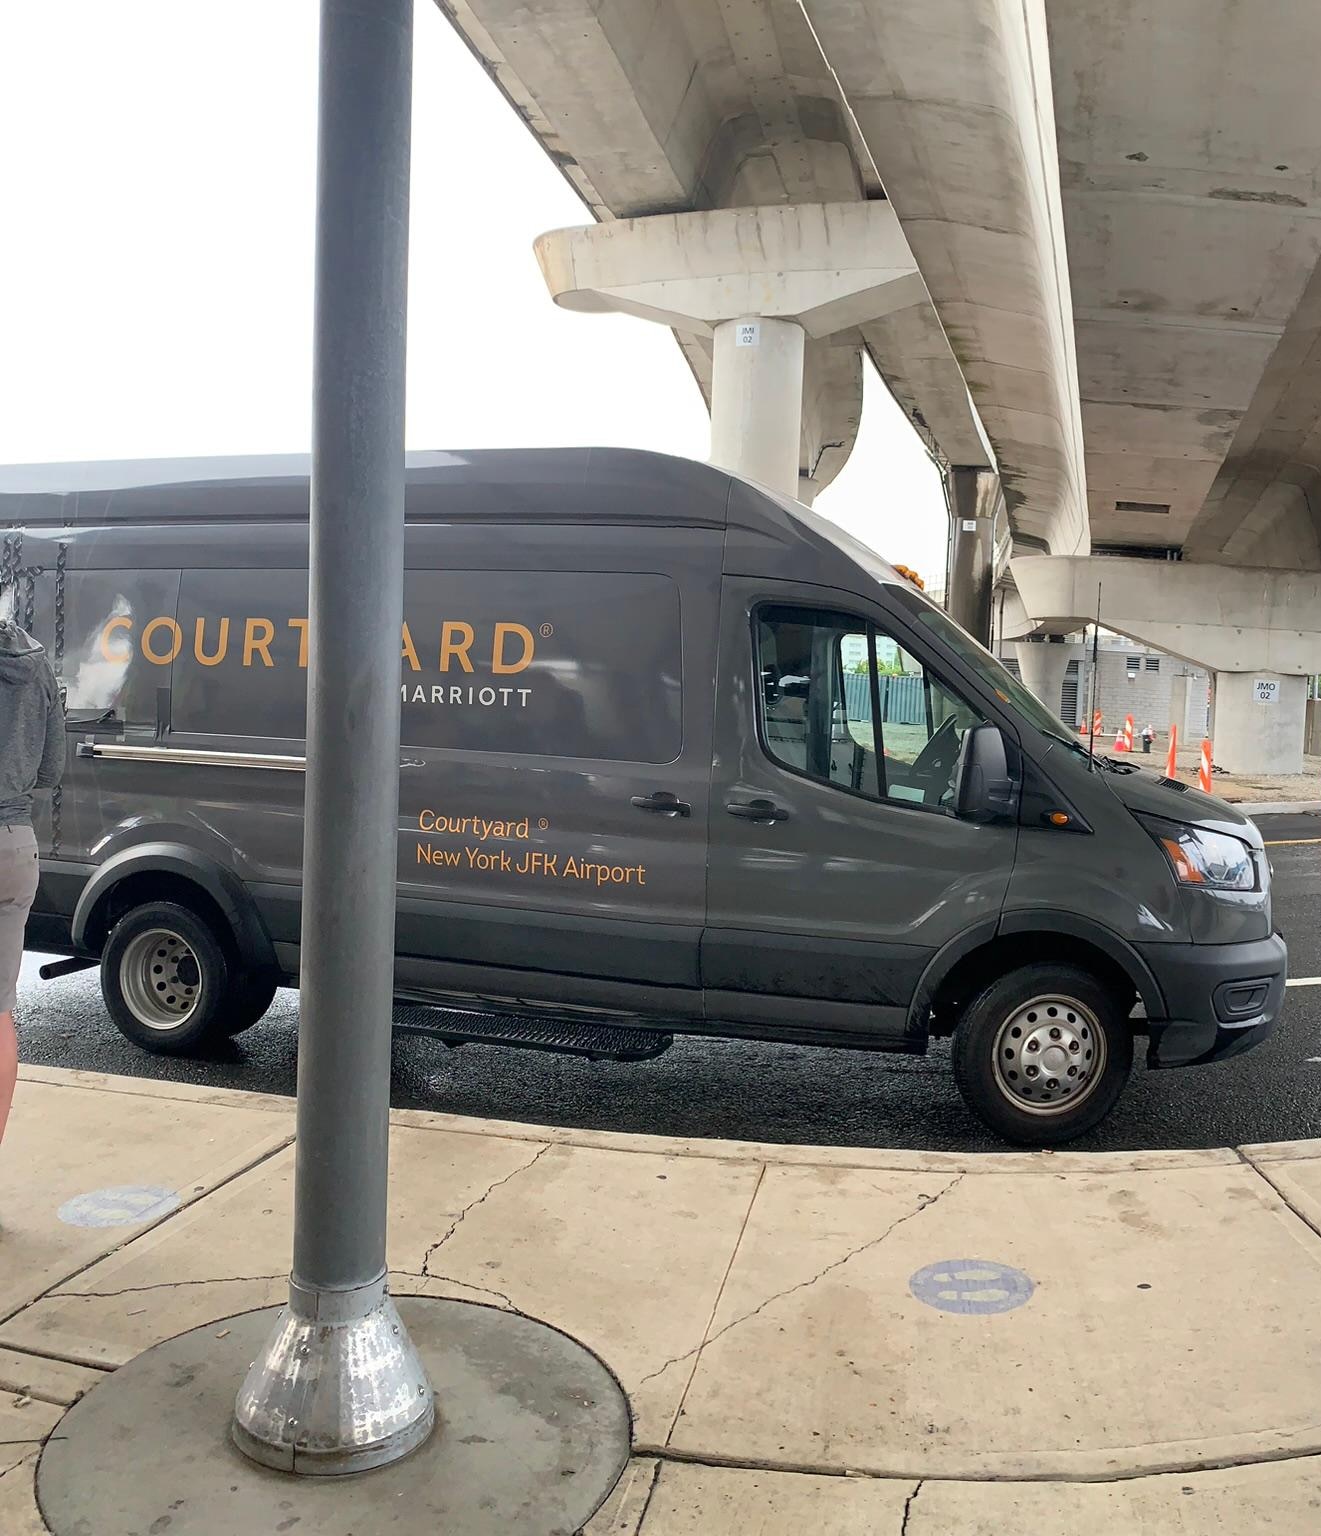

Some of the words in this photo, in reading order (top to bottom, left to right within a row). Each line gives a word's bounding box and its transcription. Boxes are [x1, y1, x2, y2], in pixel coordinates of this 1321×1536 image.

[743, 336, 753, 344] 02
[101, 616, 536, 675] COURTARD
[1256, 682, 1276, 691] JMO
[1260, 691, 1271, 700] 02
[418, 809, 529, 841] Courtyard
[416, 842, 461, 867] New
[465, 846, 511, 872] York
[516, 852, 558, 877] JFK
[563, 855, 646, 886] Airport
